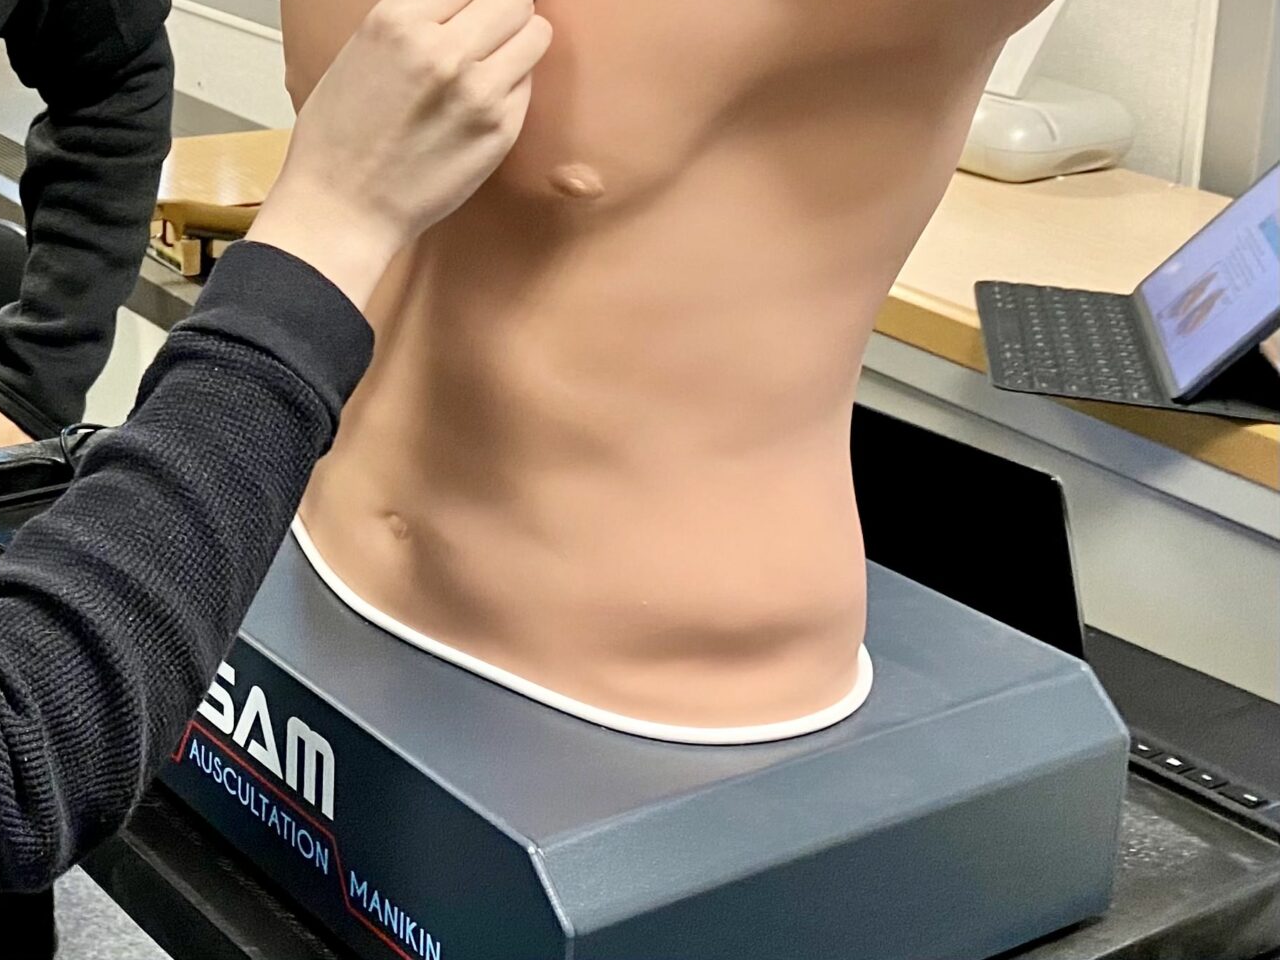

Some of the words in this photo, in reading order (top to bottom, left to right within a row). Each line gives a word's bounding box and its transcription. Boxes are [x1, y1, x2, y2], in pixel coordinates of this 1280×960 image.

[197, 660, 336, 821] SAM
[188, 738, 329, 875] AUSCULTATION
[349, 870, 441, 960] MANIKIN
